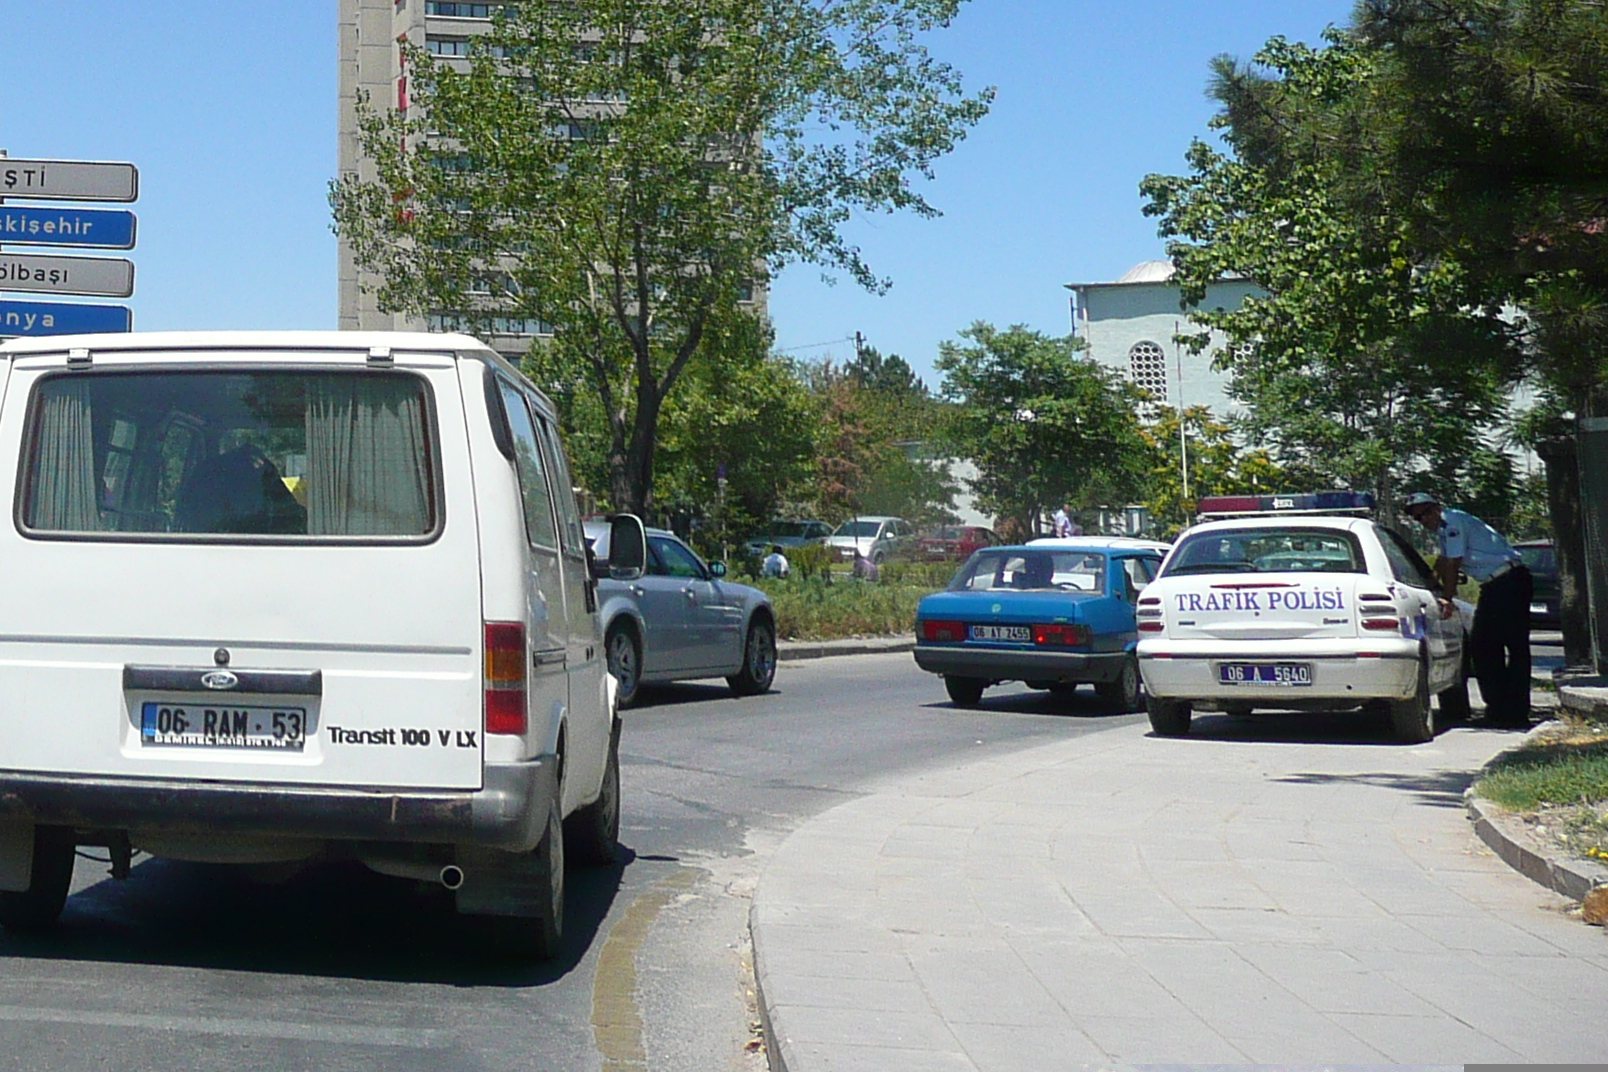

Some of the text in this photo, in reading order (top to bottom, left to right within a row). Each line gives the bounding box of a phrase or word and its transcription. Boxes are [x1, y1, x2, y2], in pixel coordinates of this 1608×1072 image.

[1175, 586, 1346, 612] TRAFİK POLİSİ
[1227, 666, 1307, 682] 06 A 5640
[158, 708, 301, 740] 06 RAM 53
[326, 727, 478, 748] Transit 100 V LX
